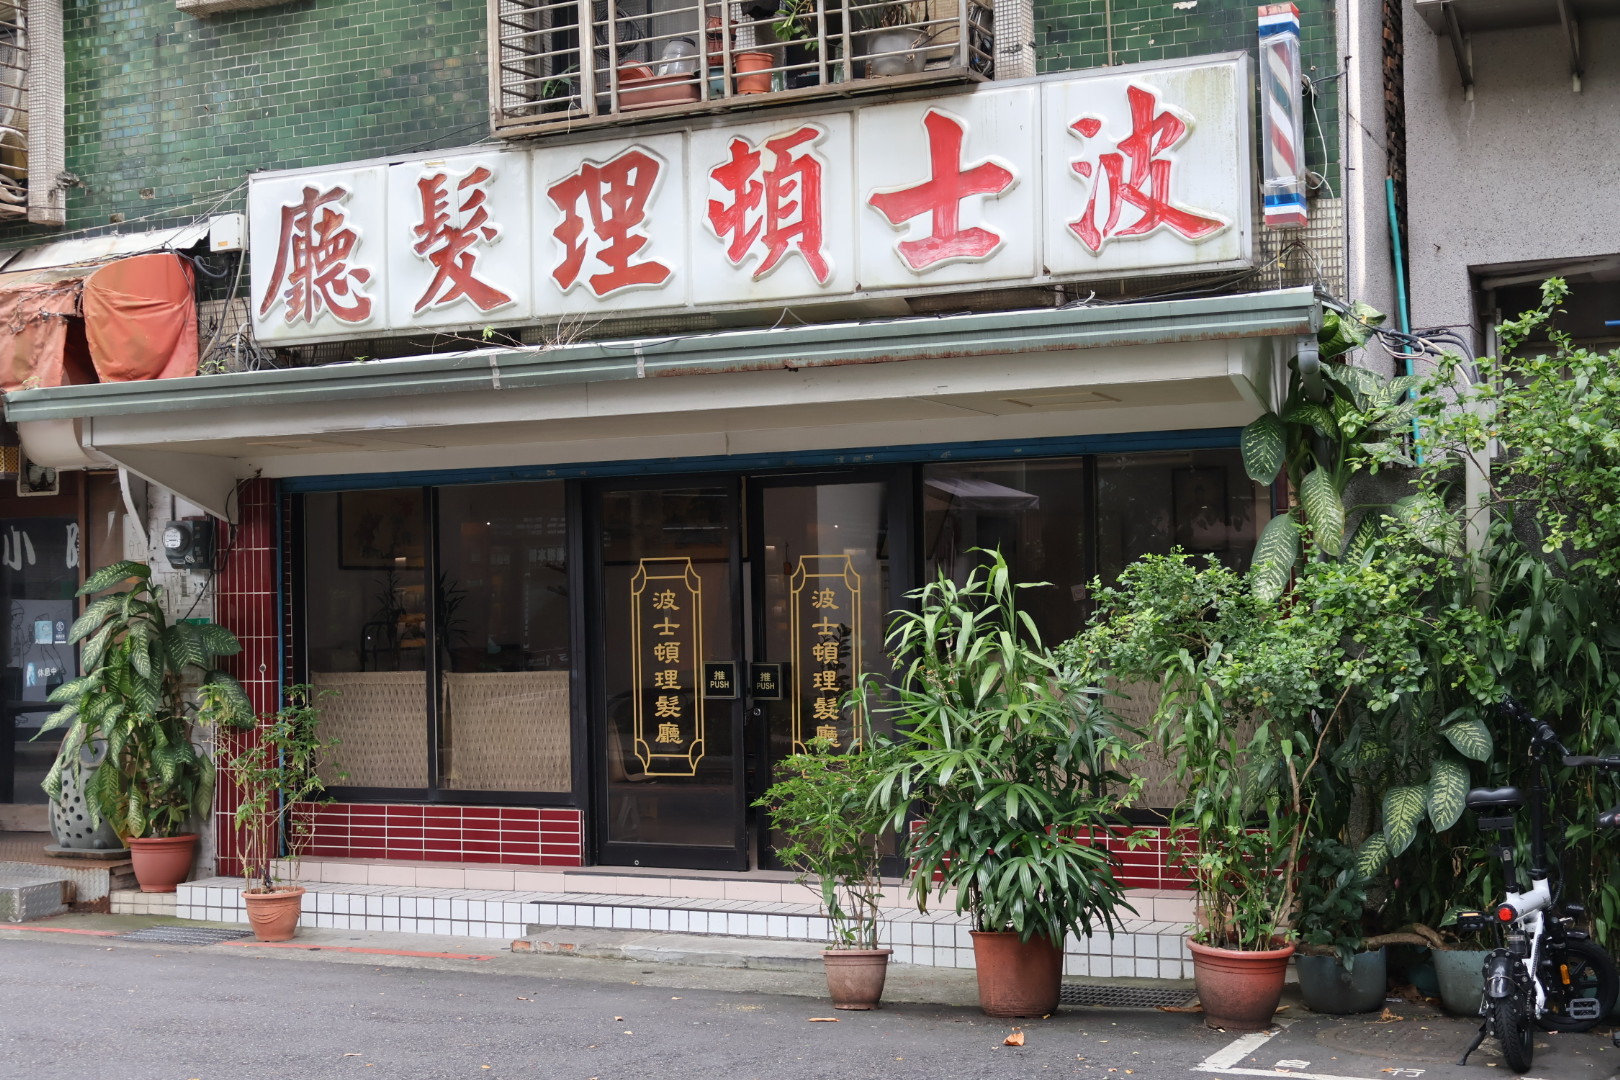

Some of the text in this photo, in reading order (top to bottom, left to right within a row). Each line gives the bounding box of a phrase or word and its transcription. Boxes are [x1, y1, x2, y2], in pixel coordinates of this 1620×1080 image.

[258, 84, 1229, 323] 波士頓理髮廳
[652, 588, 684, 744] 波士頓理髮廳
[37, 666, 57, 678] 休息中
[713, 670, 726, 681] 推
[759, 671, 772, 682] 推
[709, 680, 730, 689] PUSH
[756, 682, 775, 690] PUSH
